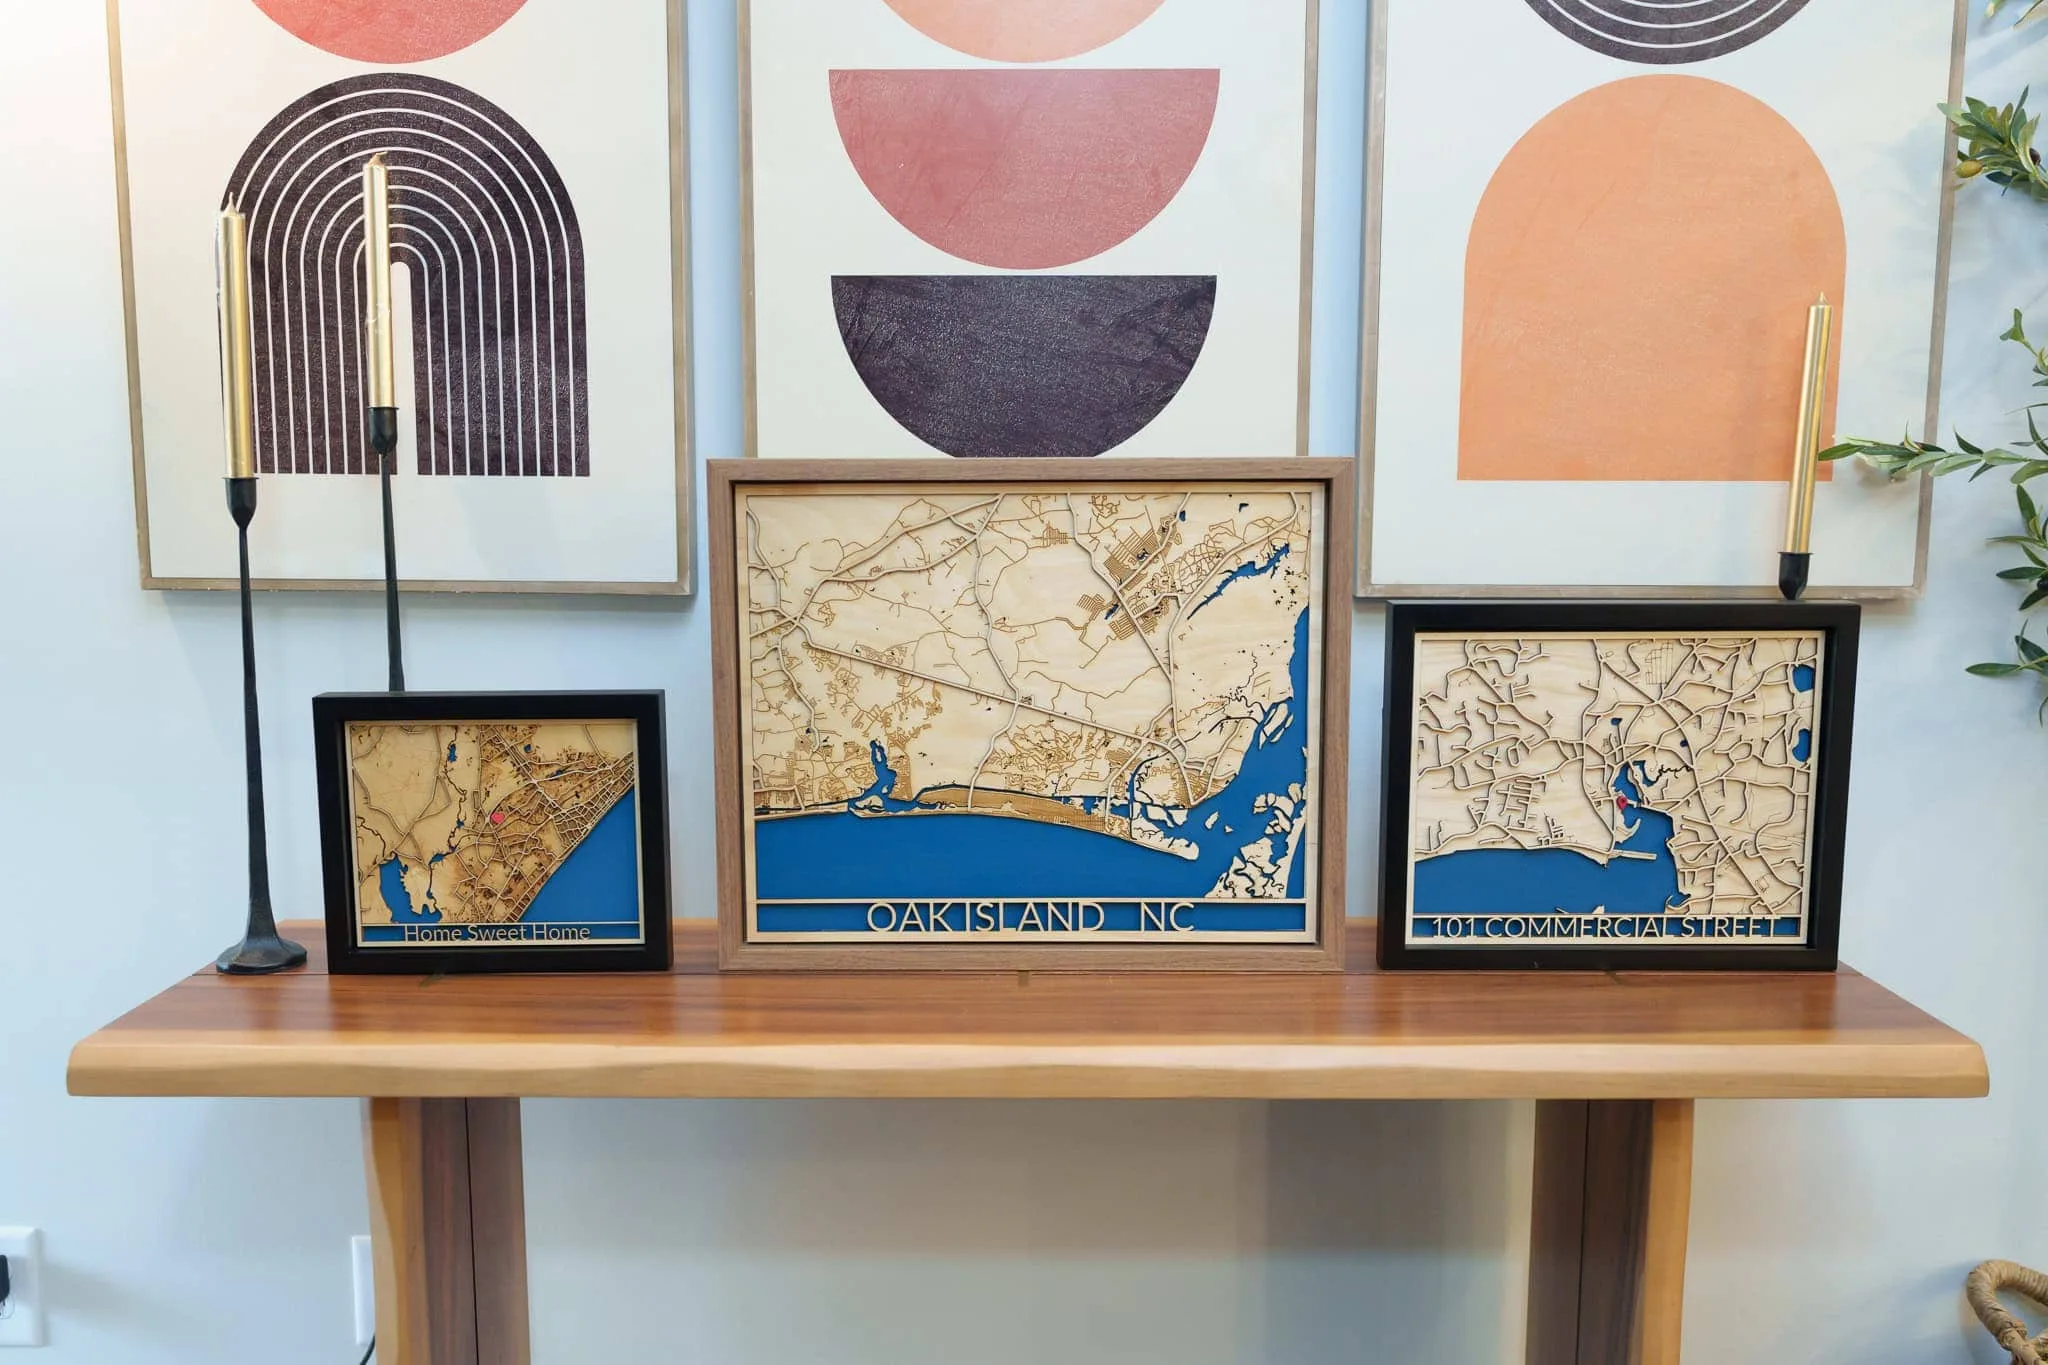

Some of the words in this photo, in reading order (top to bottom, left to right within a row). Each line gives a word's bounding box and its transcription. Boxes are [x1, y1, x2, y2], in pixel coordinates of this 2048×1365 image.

[867, 901, 953, 933] OAK
[964, 901, 1105, 933] ISLAND
[1140, 901, 1196, 933] NC
[1432, 916, 1476, 938] 101
[1485, 916, 1676, 938] COMMERCIAL
[1681, 915, 1778, 938] STREET
[404, 923, 463, 943] Home
[468, 923, 527, 943] Sweet
[532, 922, 591, 942] Home
